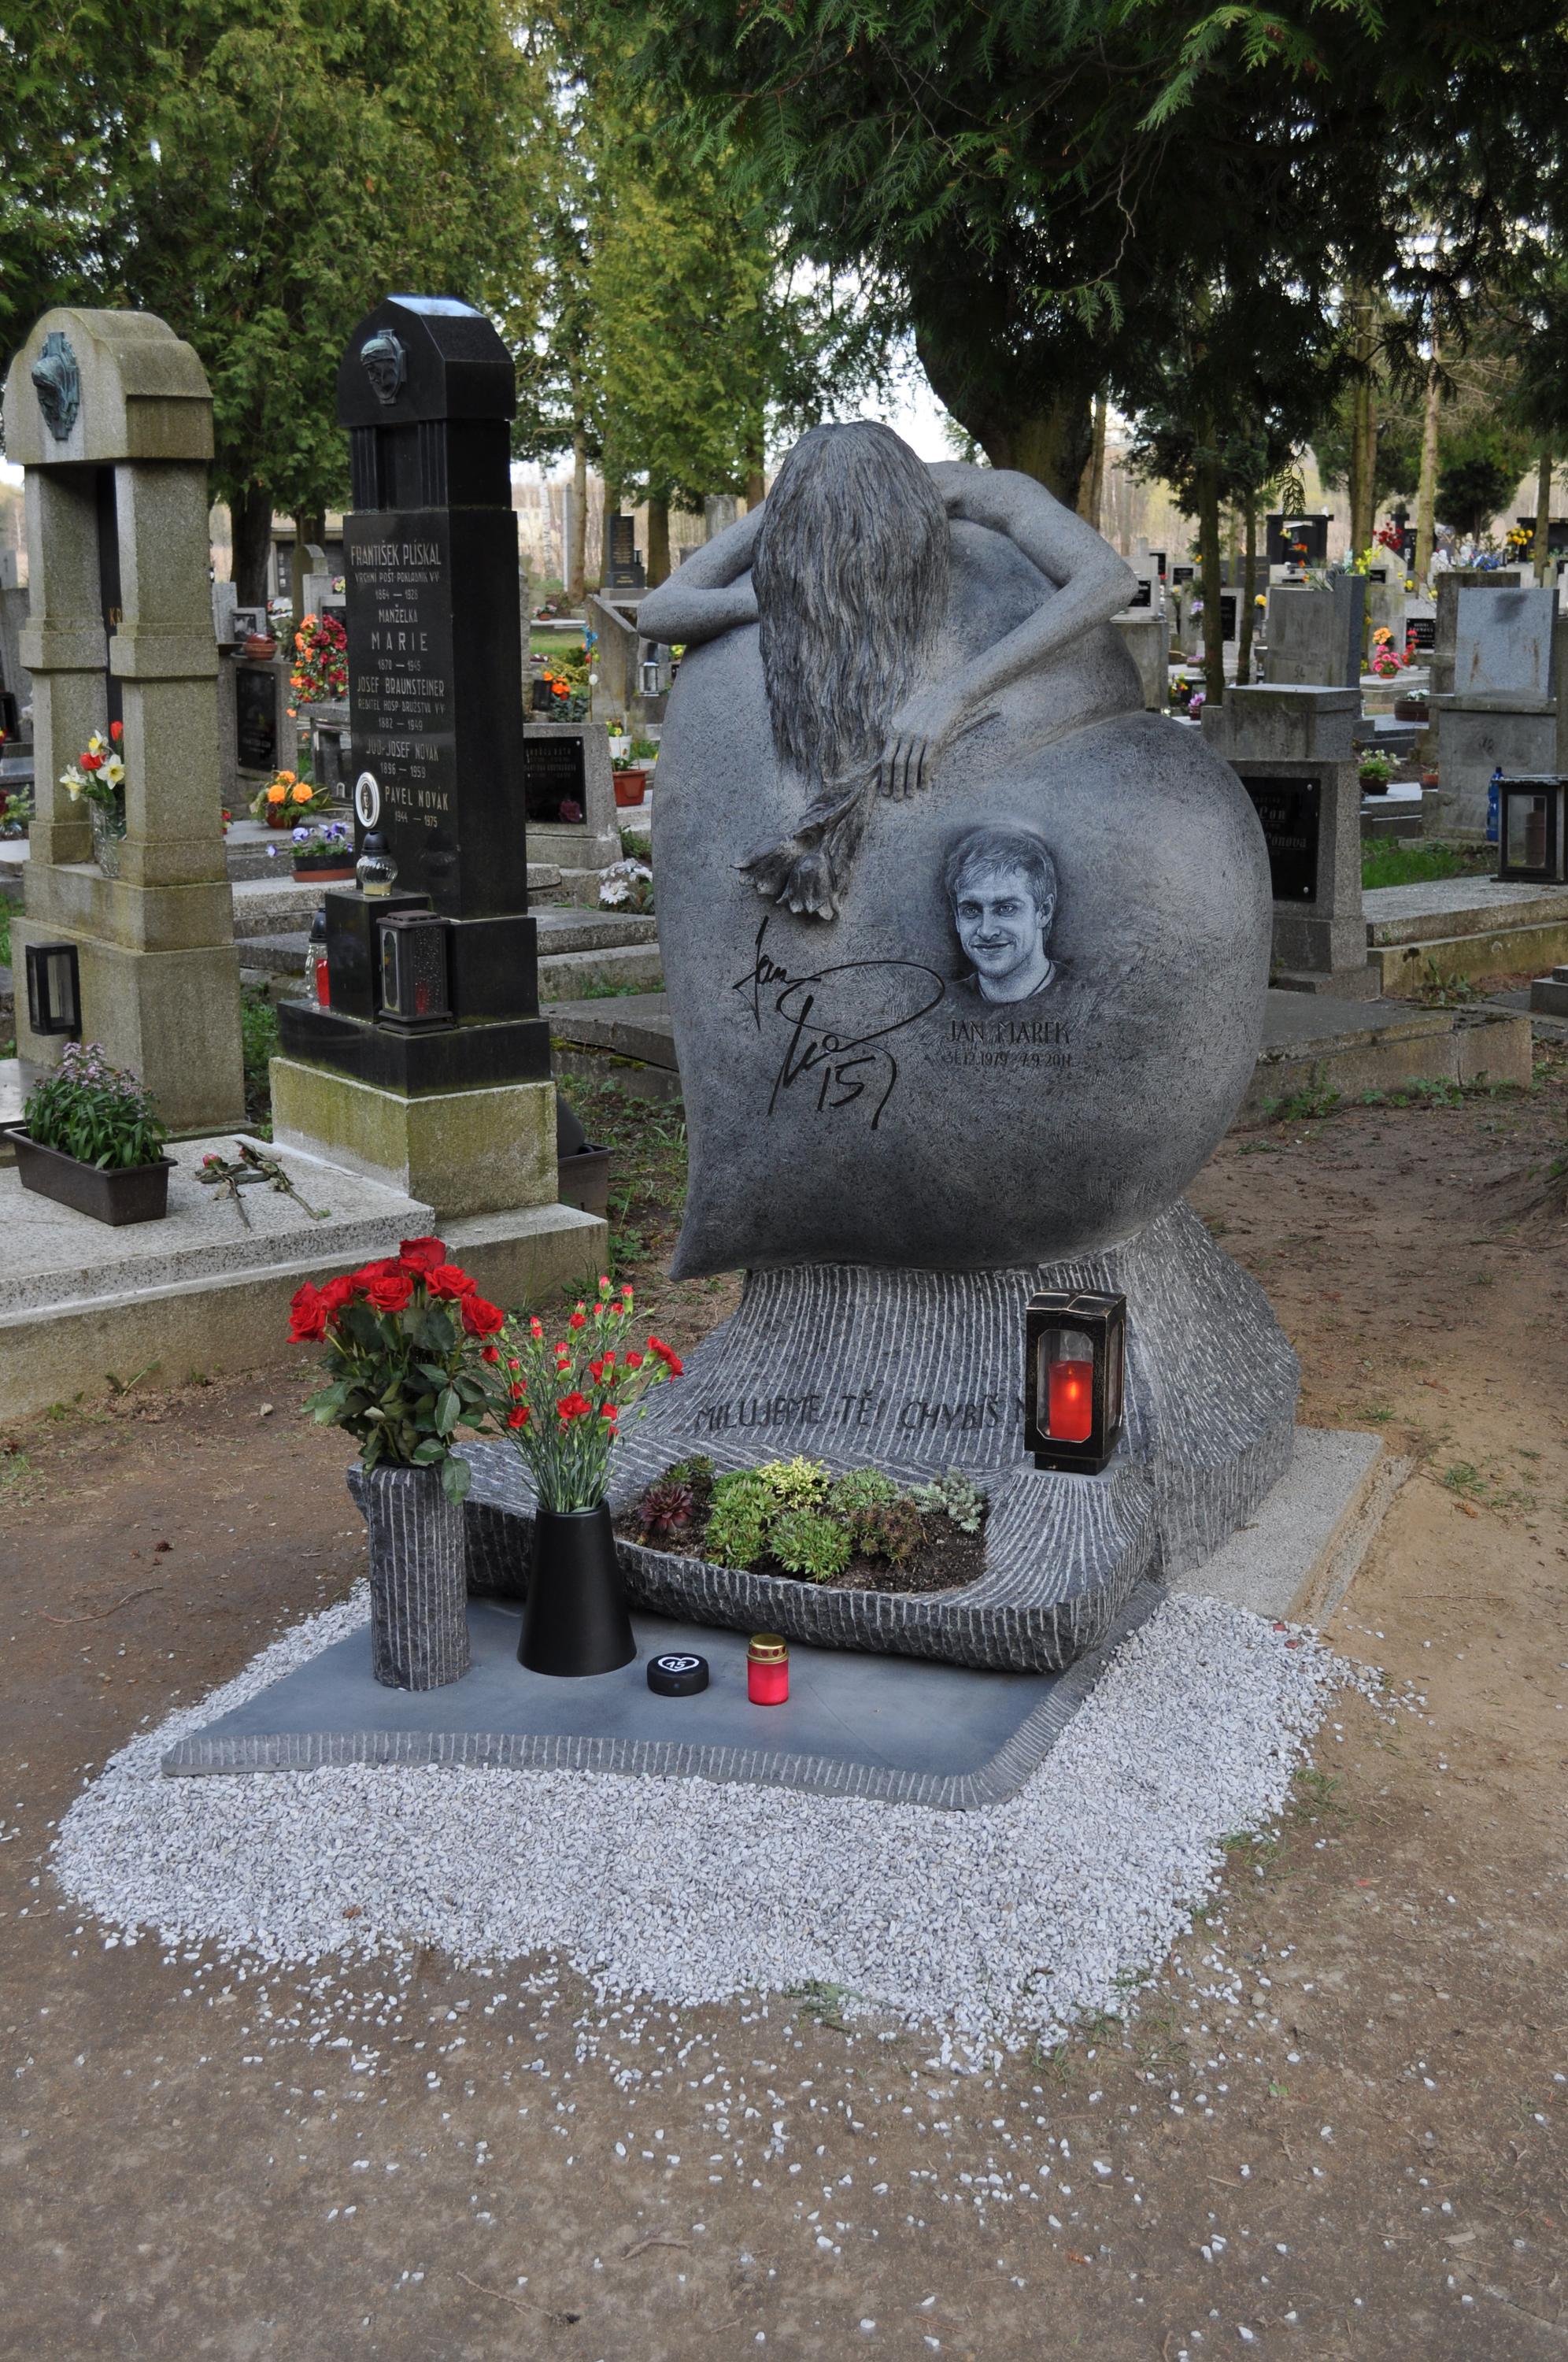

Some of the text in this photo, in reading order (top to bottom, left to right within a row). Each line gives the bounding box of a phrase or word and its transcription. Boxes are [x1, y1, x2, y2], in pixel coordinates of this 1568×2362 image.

[351, 539, 441, 566] FRANTIŠEK PLÍSKAL
[379, 604, 418, 623] MANŽELKA
[372, 632, 428, 651] MARIE
[357, 676, 445, 697] JOSEF BRAUNSTEINER
[379, 762, 396, 775] 1896
[385, 786, 449, 811] PAVEL NOVÁK
[948, 1020, 1071, 1045] JAN MAREK
[816, 1056, 877, 1112] 15
[666, 1660, 687, 1670] 15
